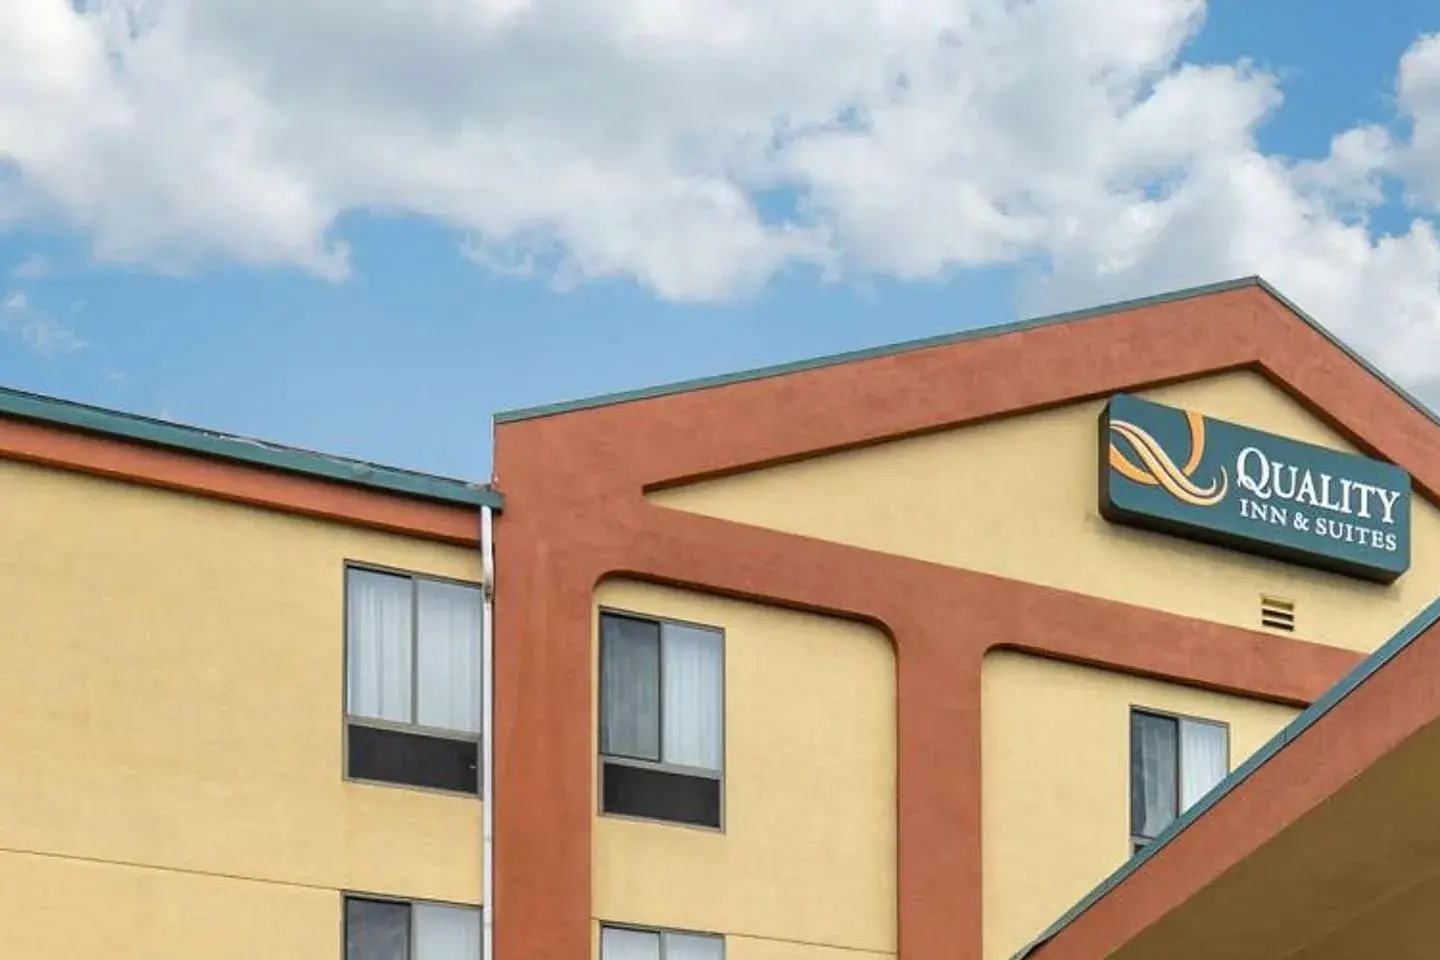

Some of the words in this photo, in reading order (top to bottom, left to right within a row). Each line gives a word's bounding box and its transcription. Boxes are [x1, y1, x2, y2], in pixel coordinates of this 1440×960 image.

[1236, 447, 1400, 523] QUALITY
[1240, 499, 1287, 526] INN
[1293, 512, 1309, 531] &
[1315, 518, 1397, 551] SUITES
